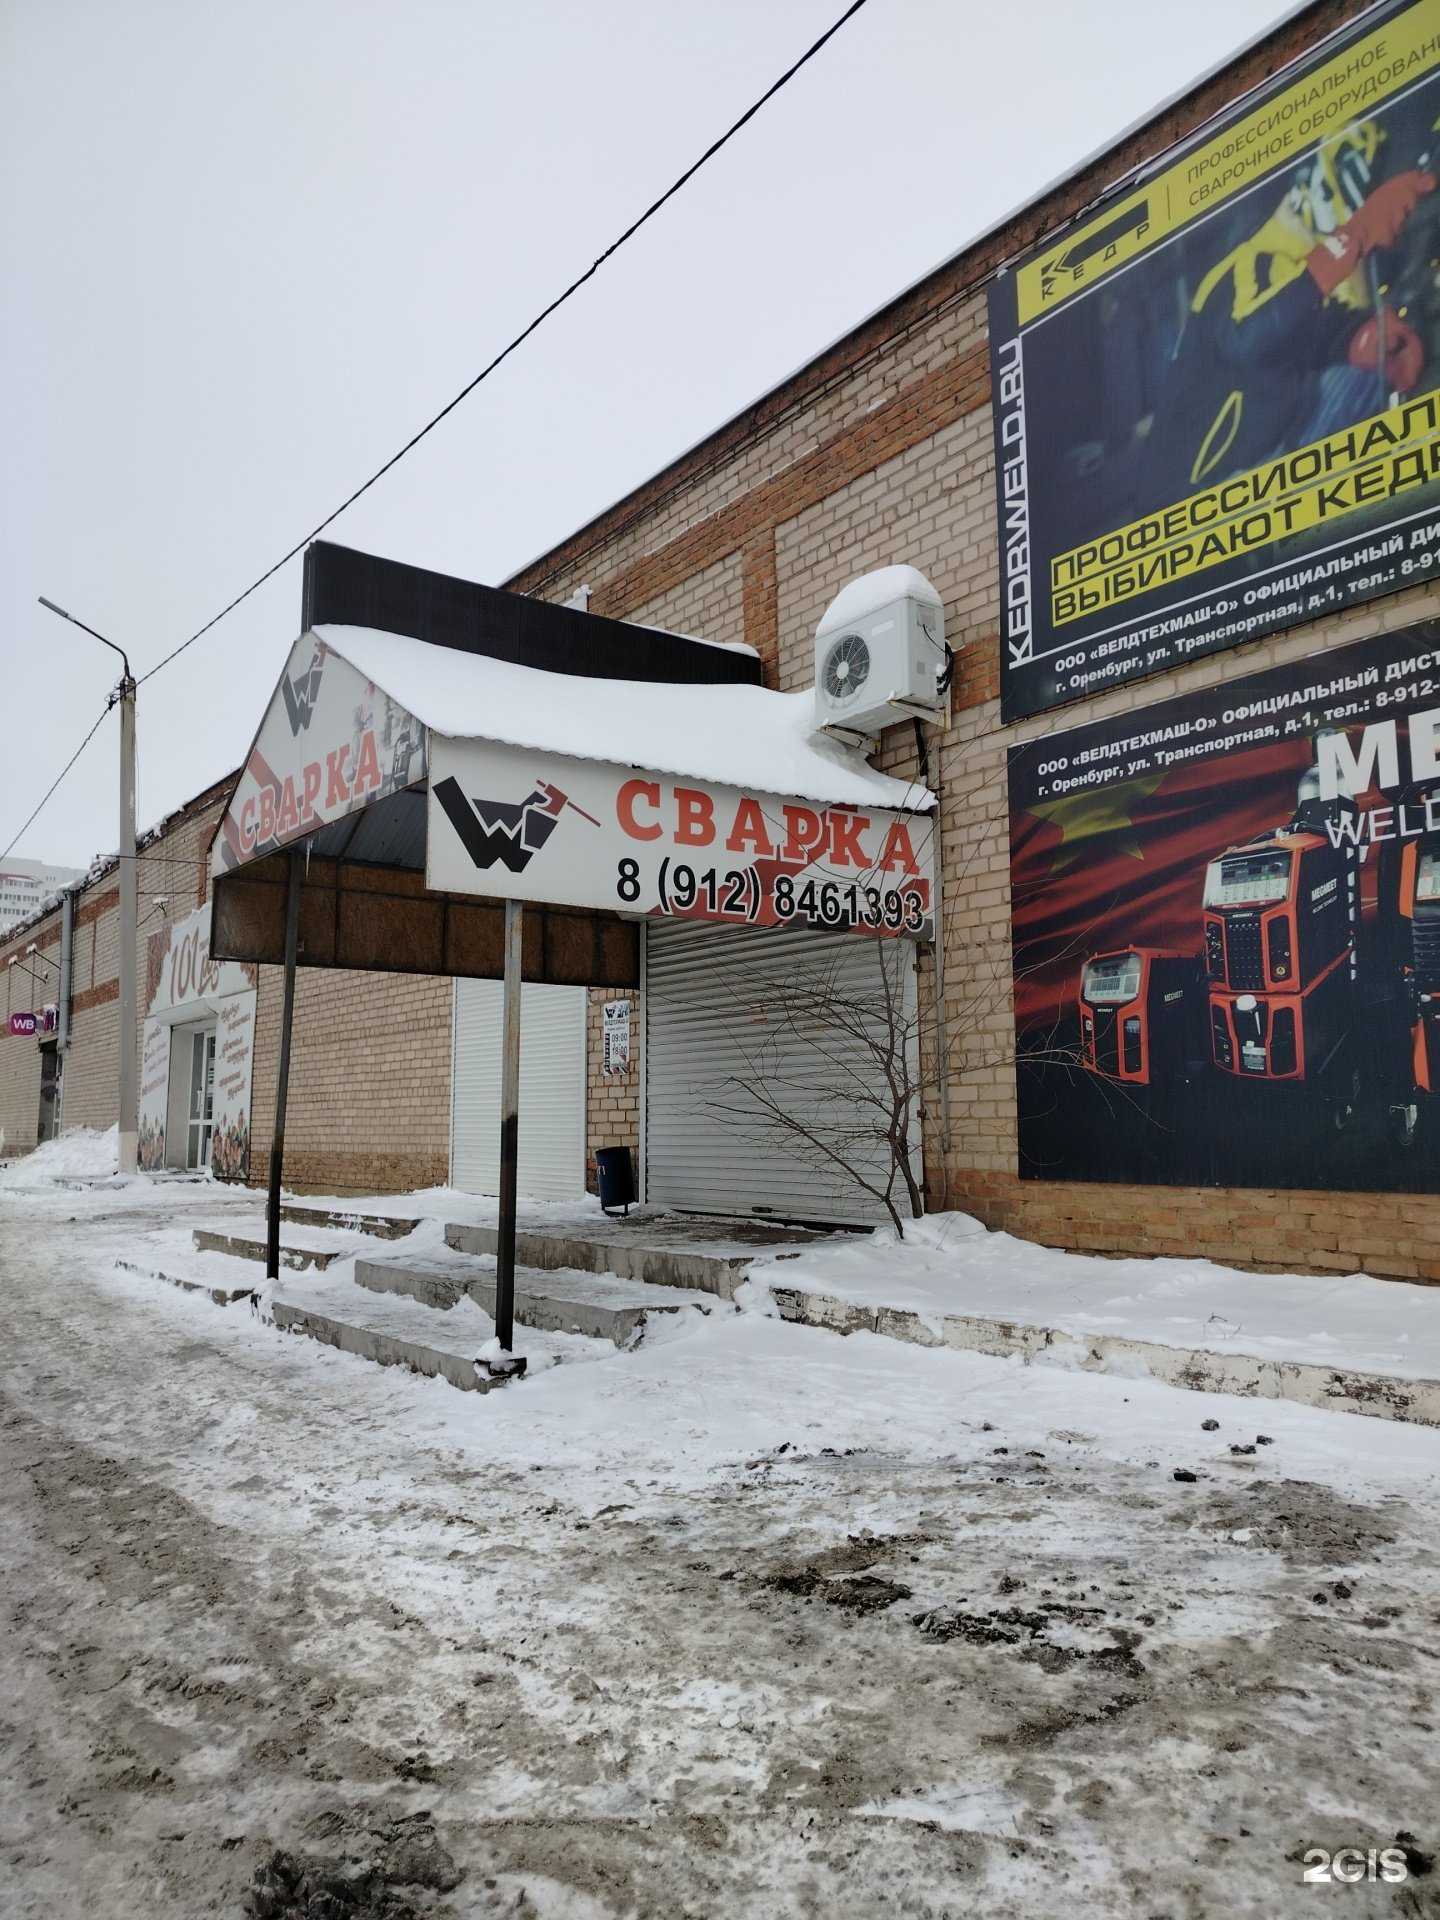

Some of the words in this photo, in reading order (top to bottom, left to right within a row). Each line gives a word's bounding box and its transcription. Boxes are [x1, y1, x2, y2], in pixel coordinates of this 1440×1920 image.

[1186, 40, 1388, 184] ПРОФЕССИОНАЛЬНОЕ
[1188, 129, 1295, 207] СВАРОЧНОЕ
[1298, 34, 1440, 136] ОБОРУДОВАН
[1041, 222, 1150, 301] КЕДР
[999, 336, 1033, 670] KEDRWELD.RU
[1053, 397, 1440, 587] ПРОФЕССИОНАЛ
[1054, 498, 1302, 623] ВЫБИРАЮТ
[1055, 651, 1086, 672] ООО
[1243, 534, 1404, 606] ОФИЦИАЛЬНЫЙ
[1055, 681, 1067, 693] г.
[1069, 656, 1144, 688] Оренбург,
[1147, 647, 1171, 665] ул.
[1175, 602, 1303, 653] Транспортная,
[1308, 585, 1344, 609] д.1,
[1348, 568, 1395, 593] тел.:
[1037, 757, 1068, 776] ООО
[1222, 667, 1379, 724] ОФИЦИАЛЬНЫЙ
[1038, 785, 1049, 796] г.
[1052, 765, 1124, 793] Оренбург,
[1127, 758, 1151, 776] ул.
[1154, 724, 1280, 766] Транспортная,
[1285, 712, 1319, 735] д.1,
[1323, 700, 1370, 721] тел.:
[239, 731, 382, 851] СВАРКА
[616, 778, 921, 876] СВАРКА
[616, 857, 641, 902] 8
[658, 857, 760, 920] (912)
[775, 876, 924, 931] 8461393
[13, 1018, 34, 1030] WB
